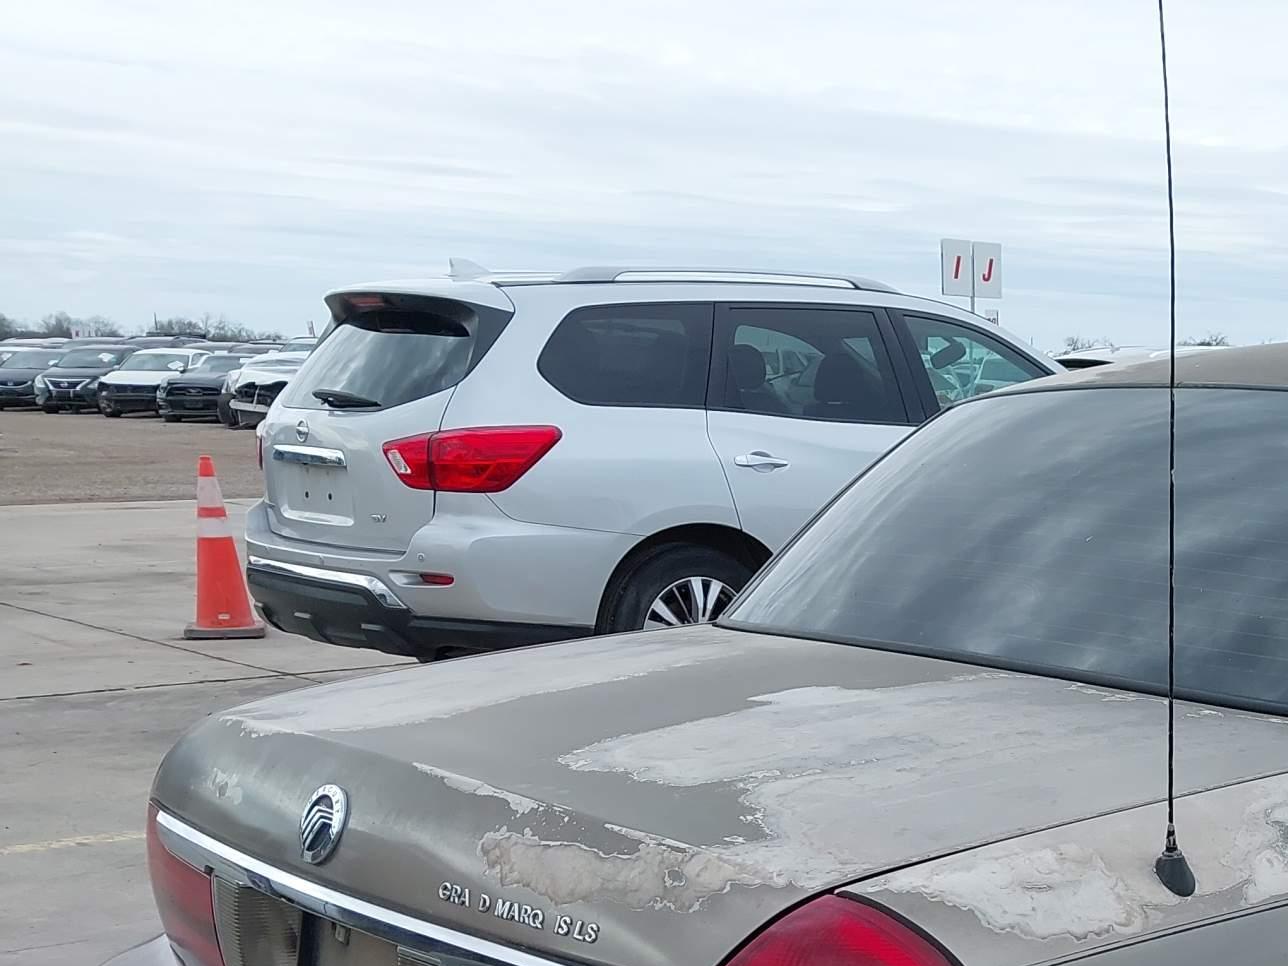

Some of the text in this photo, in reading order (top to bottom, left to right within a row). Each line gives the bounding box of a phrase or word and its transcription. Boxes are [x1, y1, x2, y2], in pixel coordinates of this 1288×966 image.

[954, 255, 994, 282] I J
[438, 881, 471, 908] GRA
[478, 893, 490, 912] D
[494, 898, 545, 929] MARQ
[573, 919, 600, 943] LS
